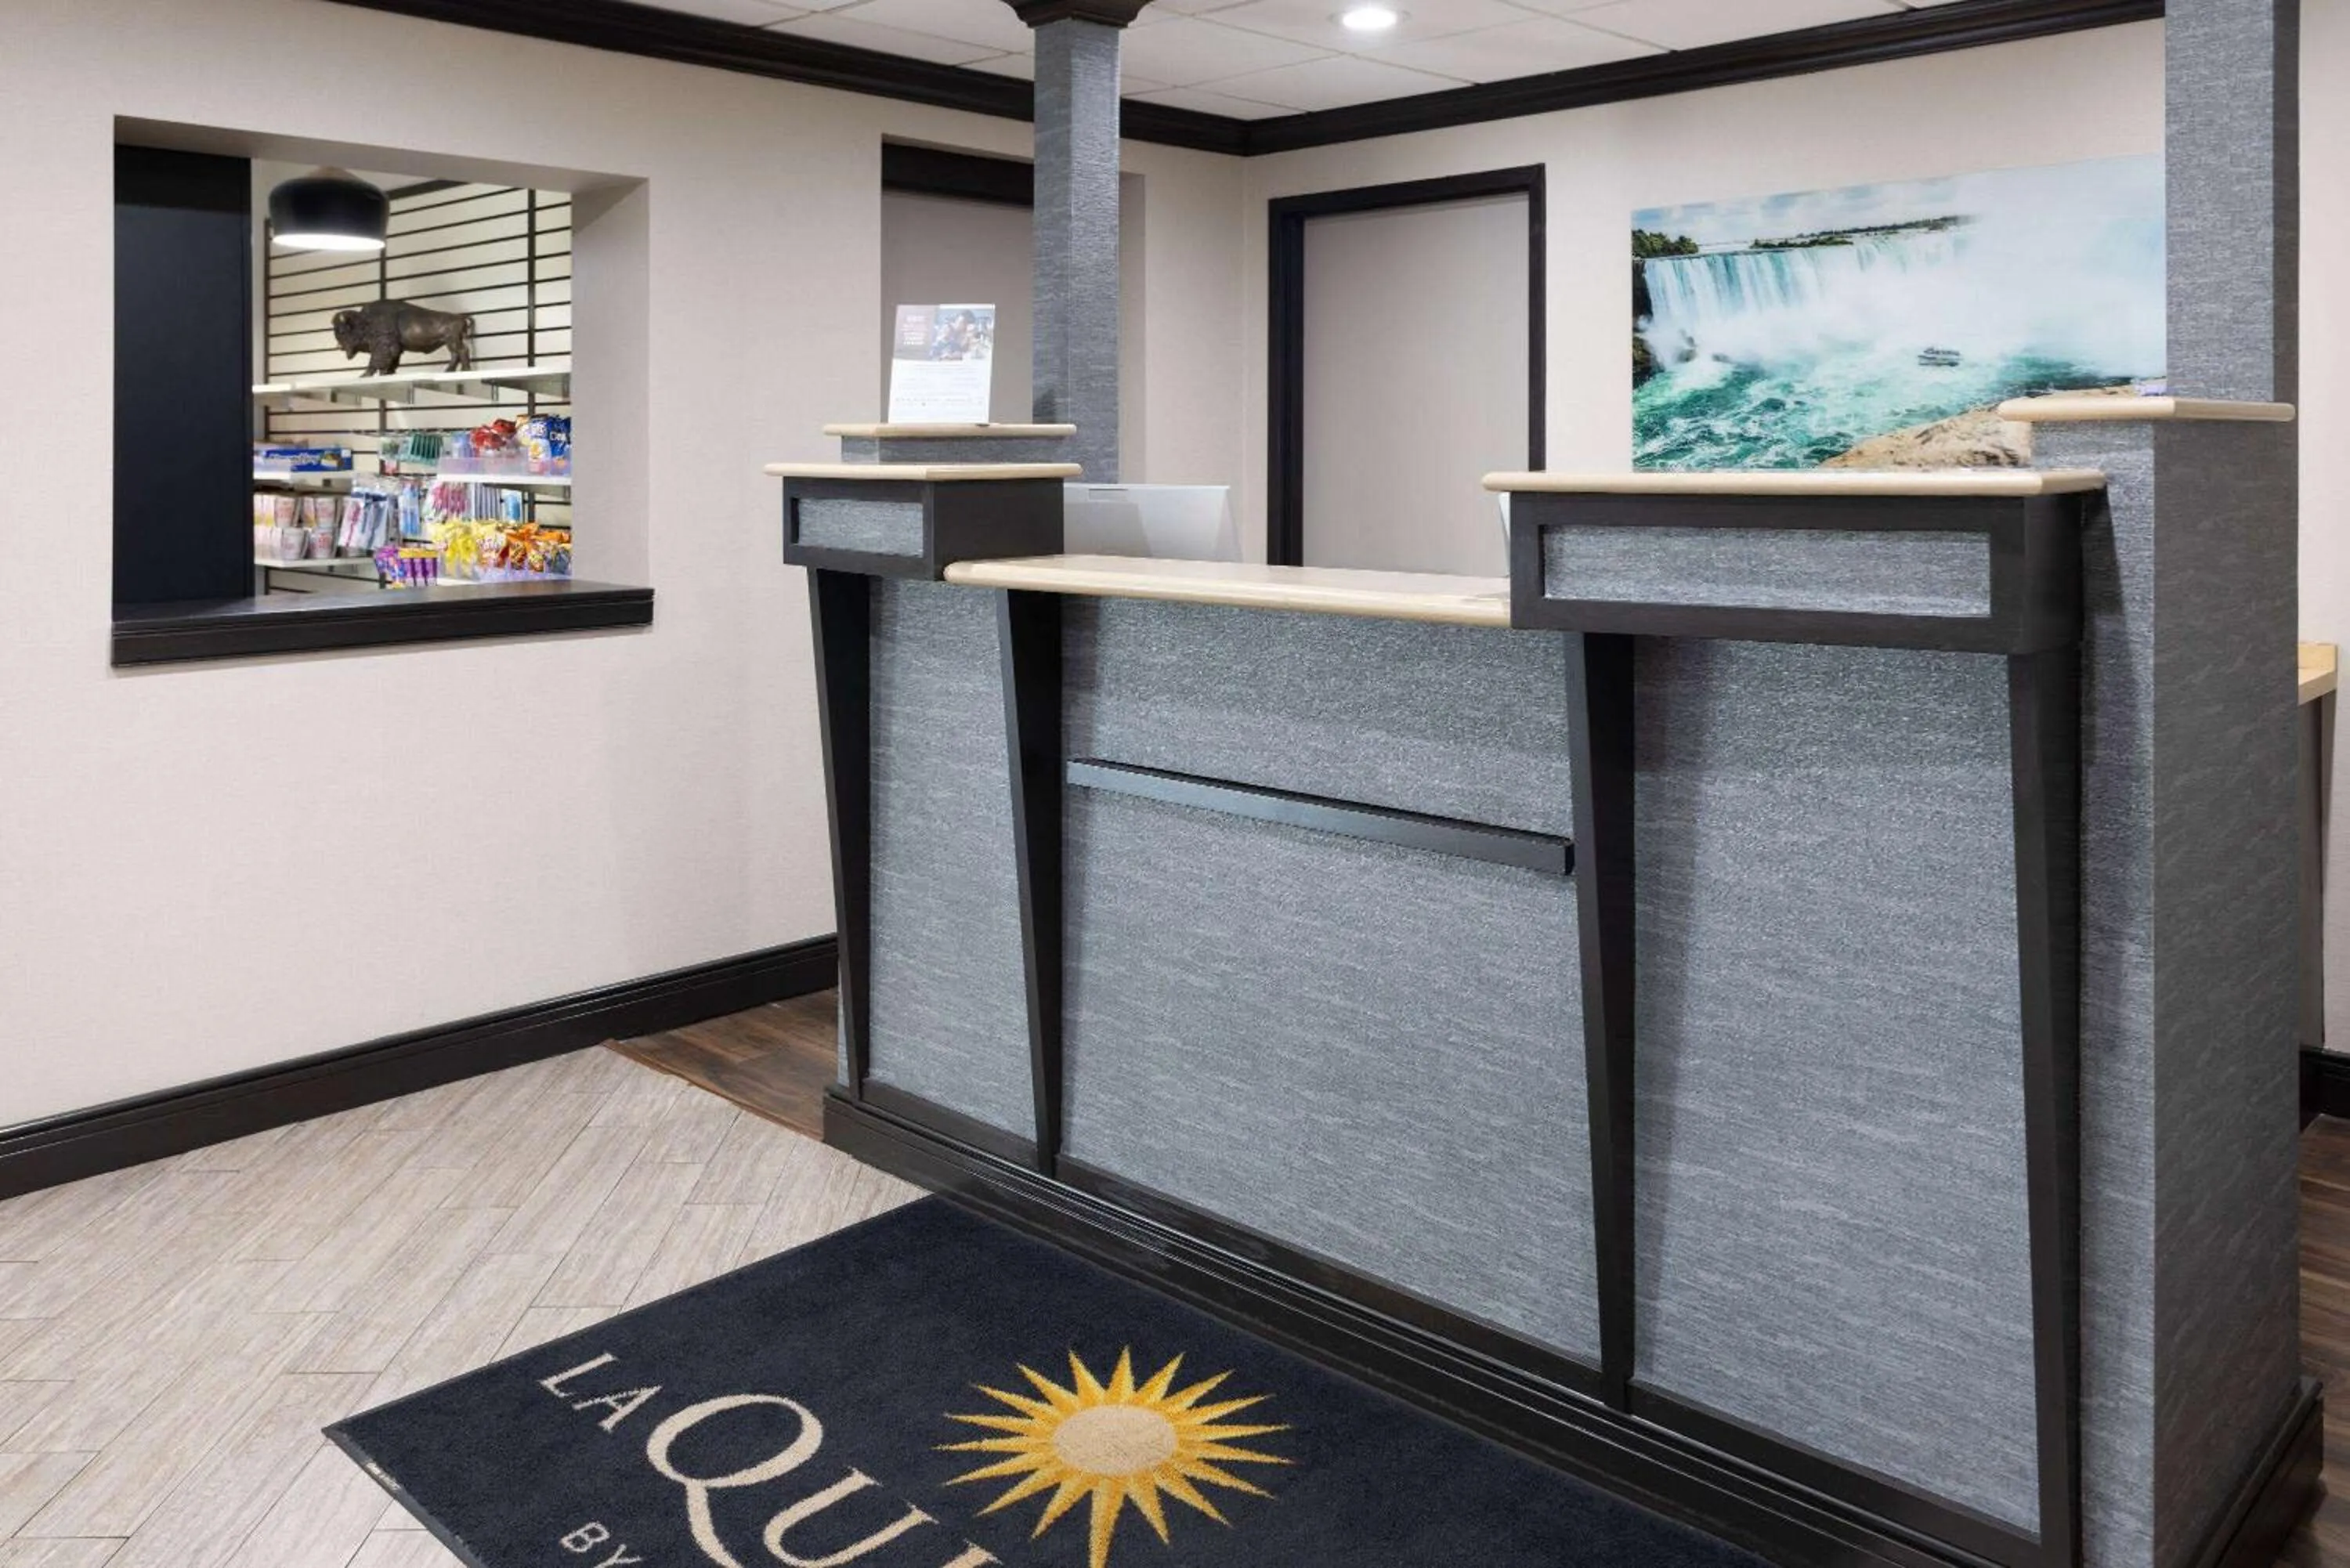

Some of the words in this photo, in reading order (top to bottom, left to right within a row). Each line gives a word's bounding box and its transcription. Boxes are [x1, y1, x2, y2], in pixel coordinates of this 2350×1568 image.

[539, 1352, 662, 1433] LA
[646, 1393, 1000, 1568] QU
[560, 1521, 642, 1568] BY
